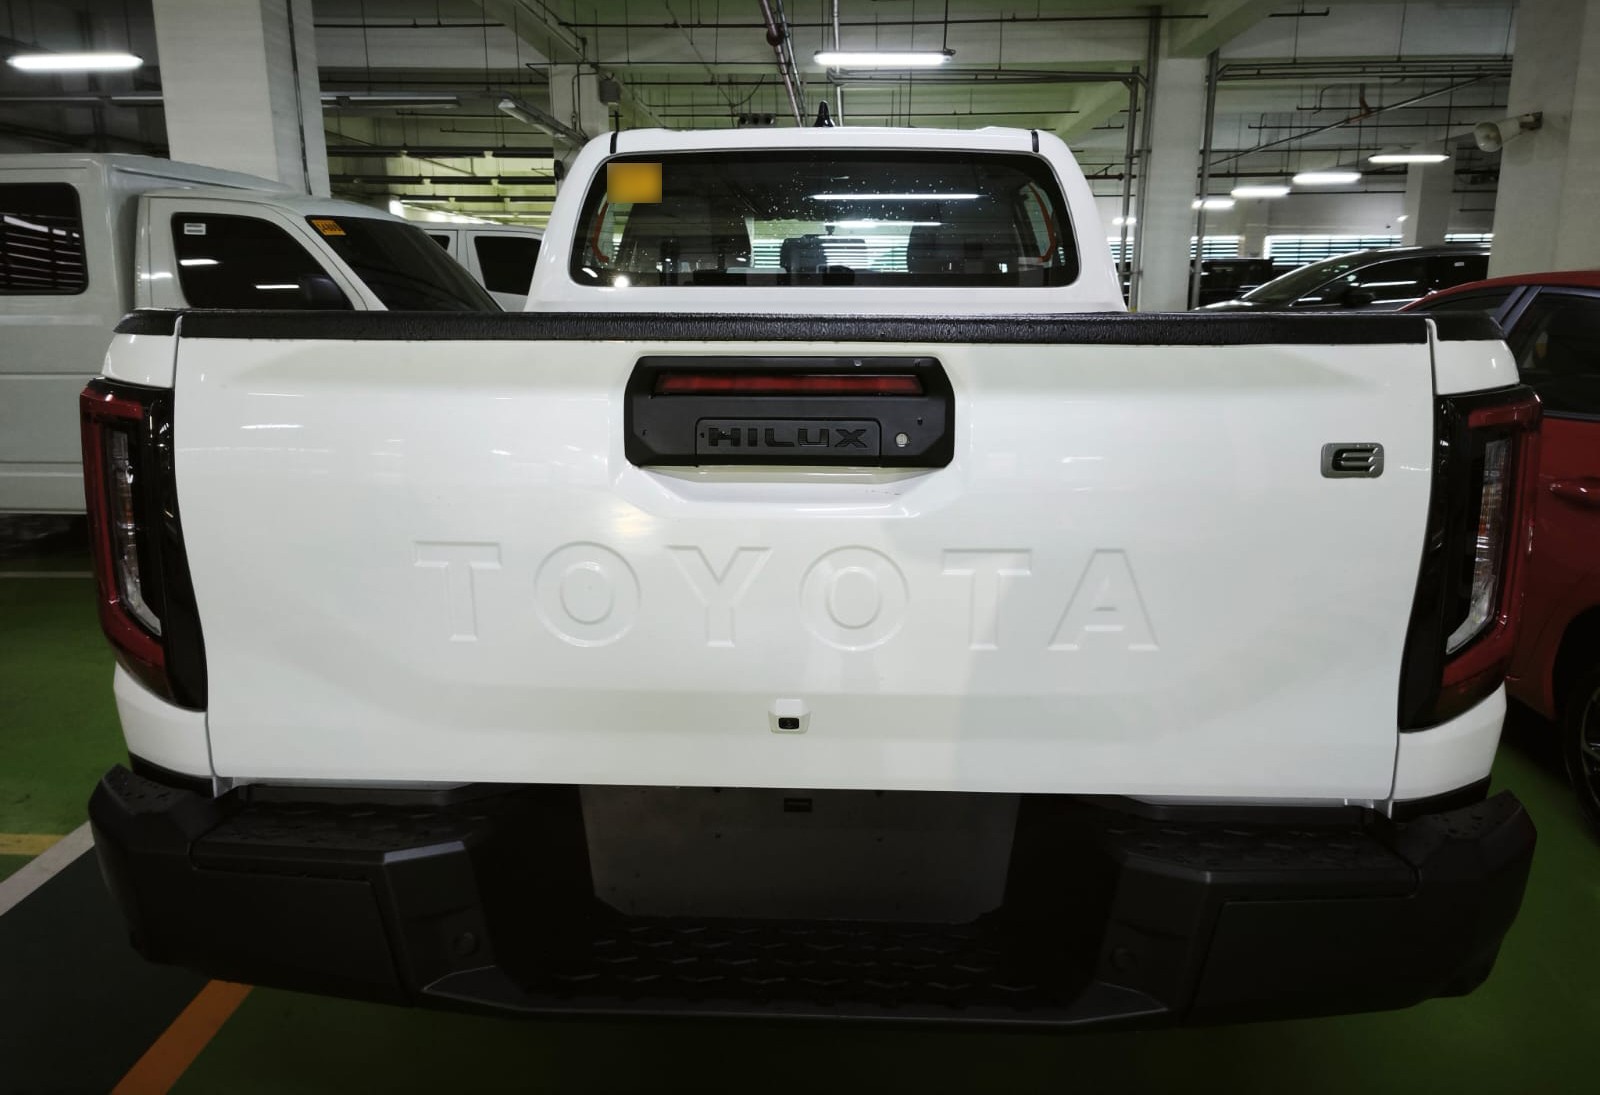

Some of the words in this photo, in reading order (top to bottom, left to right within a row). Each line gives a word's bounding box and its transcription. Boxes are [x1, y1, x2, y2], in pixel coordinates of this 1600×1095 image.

[708, 427, 868, 448] HILUX
[1331, 447, 1378, 472] E
[413, 540, 1160, 651] TOYOTA
